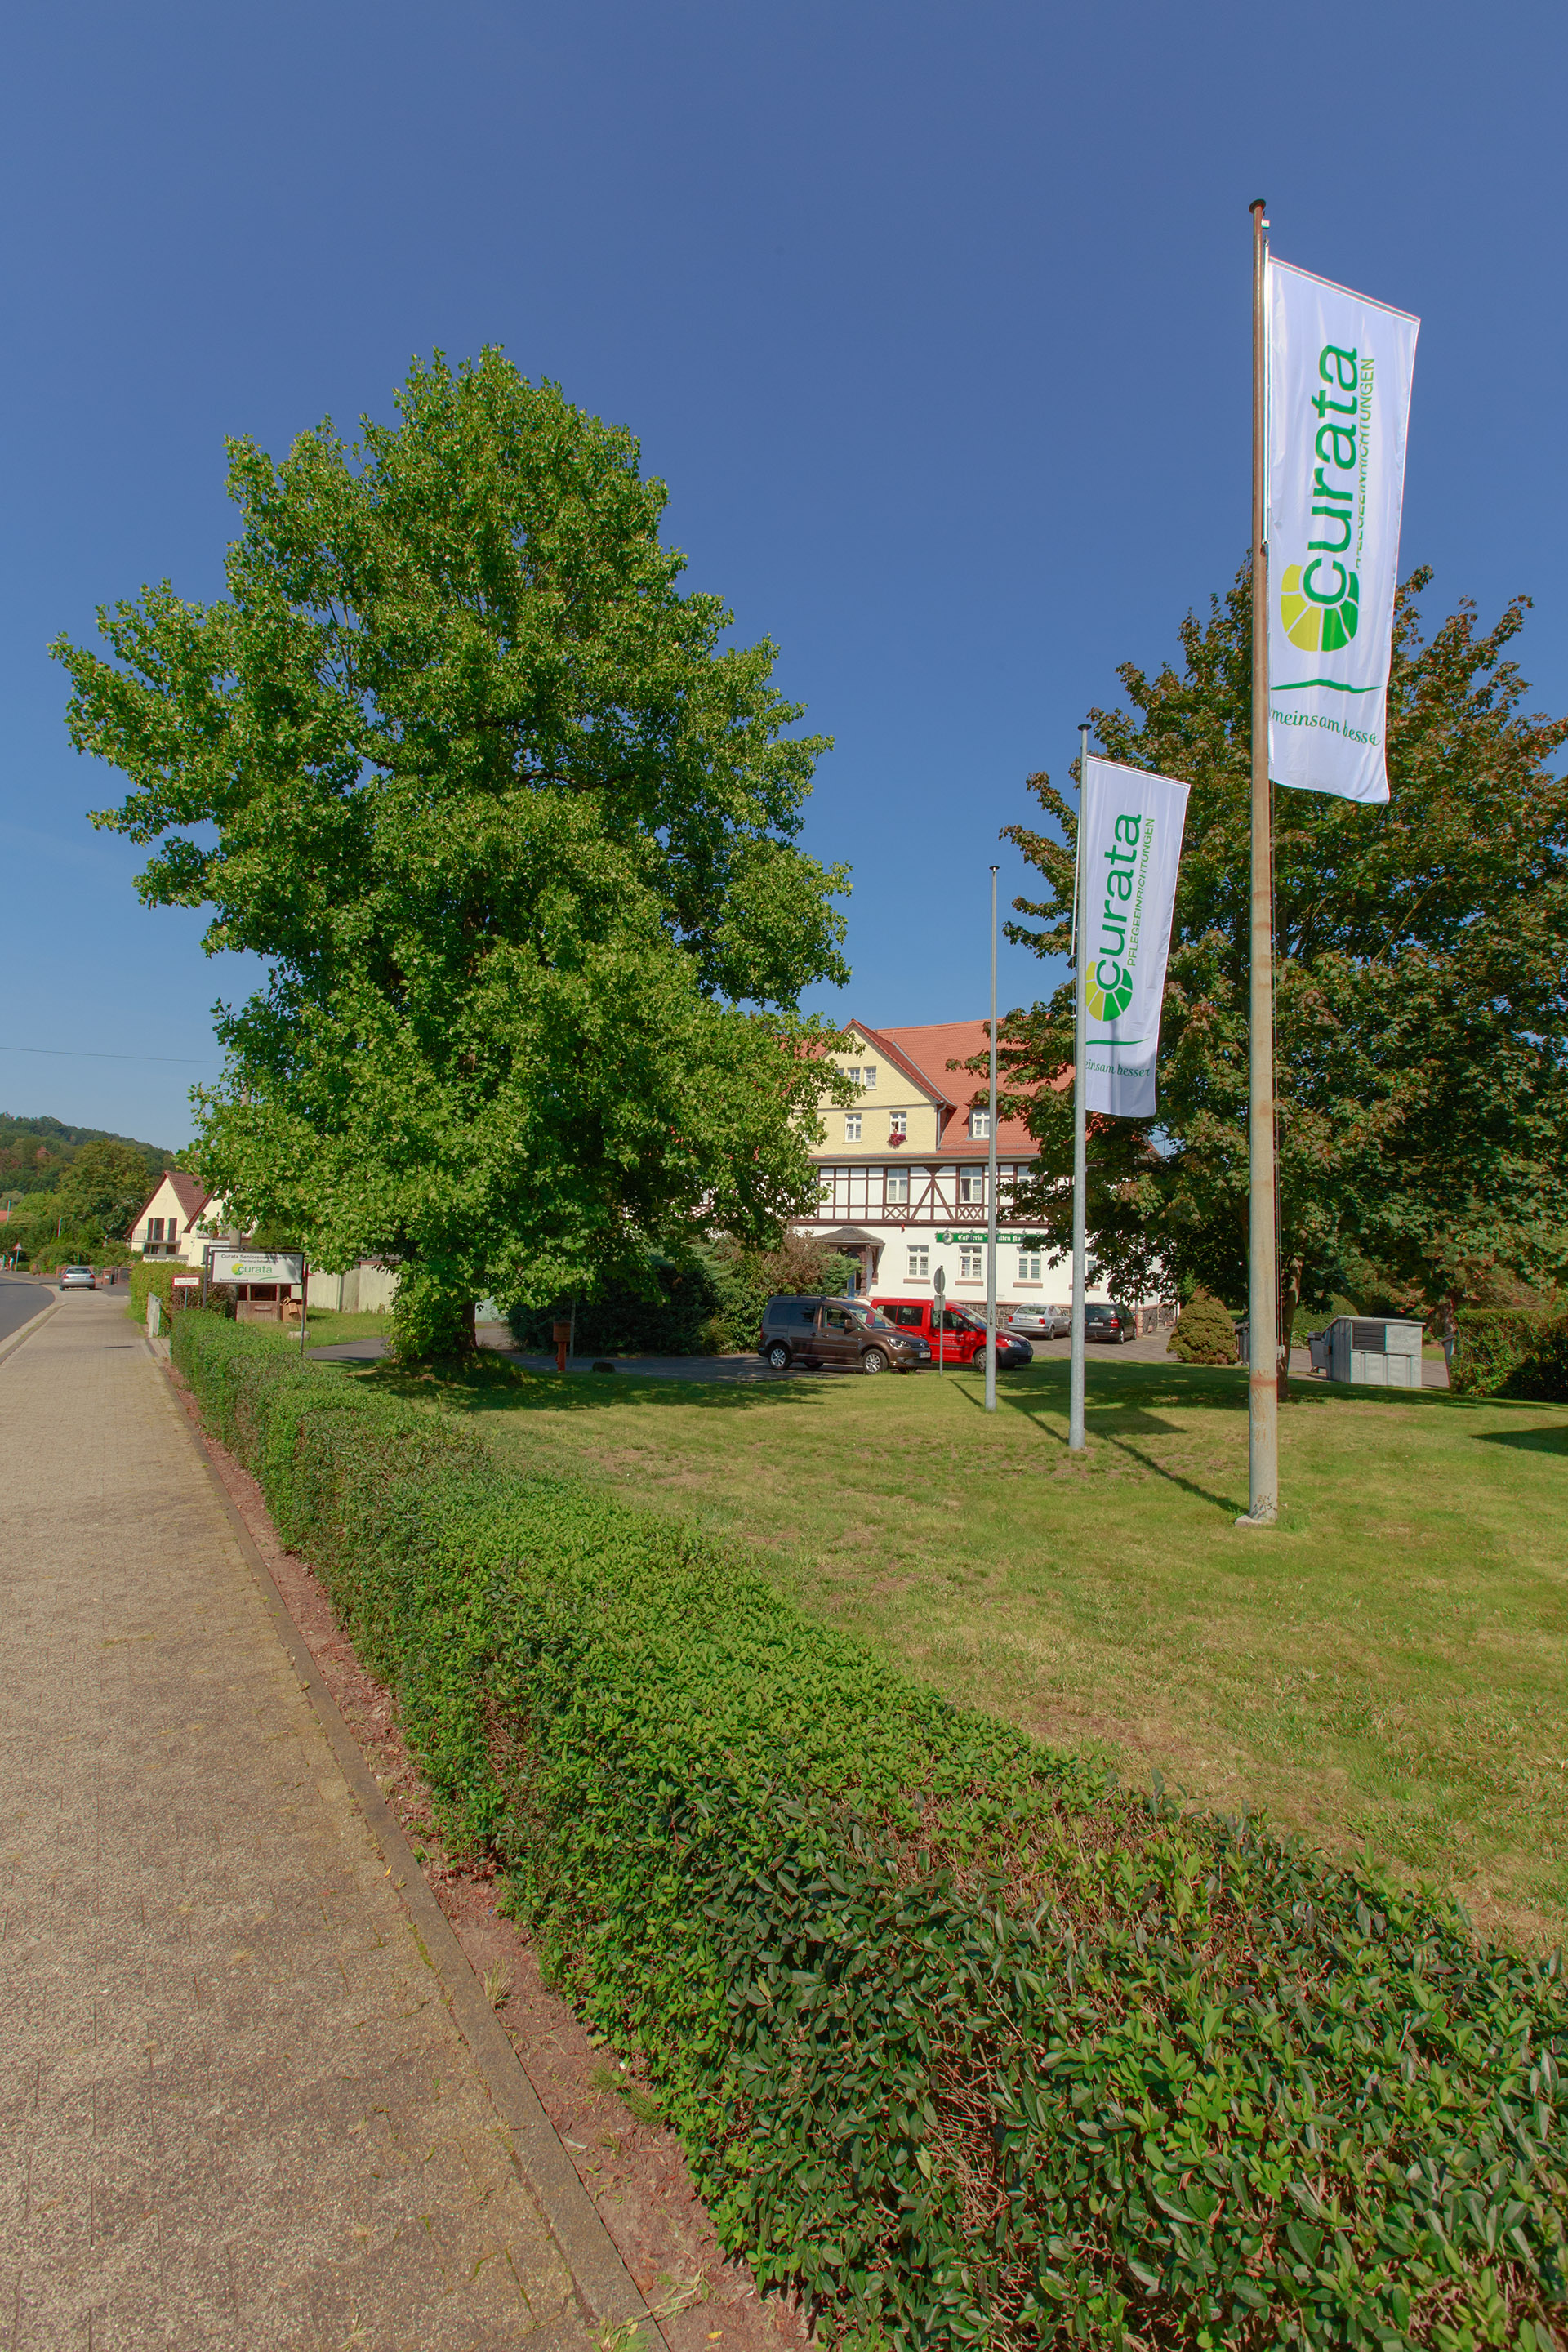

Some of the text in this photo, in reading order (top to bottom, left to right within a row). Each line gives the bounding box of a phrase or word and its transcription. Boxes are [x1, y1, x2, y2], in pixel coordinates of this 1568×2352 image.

[1302, 345, 1358, 604] curata
[1097, 813, 1142, 991] curata
[1127, 818, 1155, 966] PFLEGEEINRICHTUNGEN
[238, 1265, 273, 1273] curata
